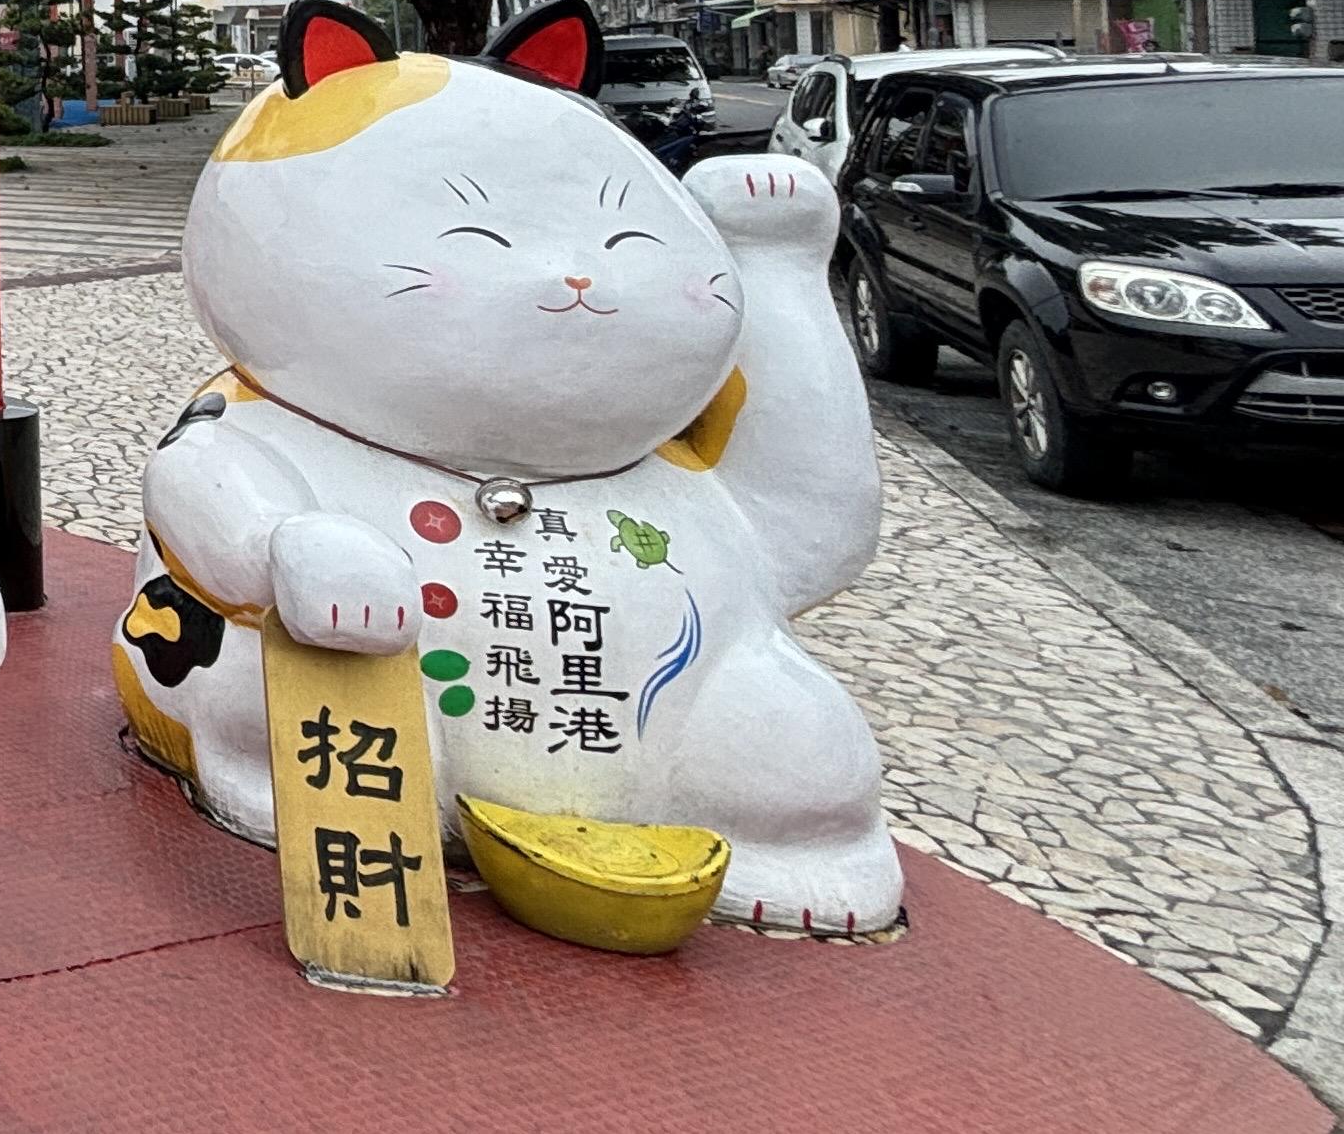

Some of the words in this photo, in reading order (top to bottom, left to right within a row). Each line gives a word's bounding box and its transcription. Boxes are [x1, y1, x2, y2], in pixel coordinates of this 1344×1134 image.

[473, 540, 541, 735] 幸福飛揚
[531, 507, 630, 754] 真愛阿里港
[297, 705, 423, 928] 招財
